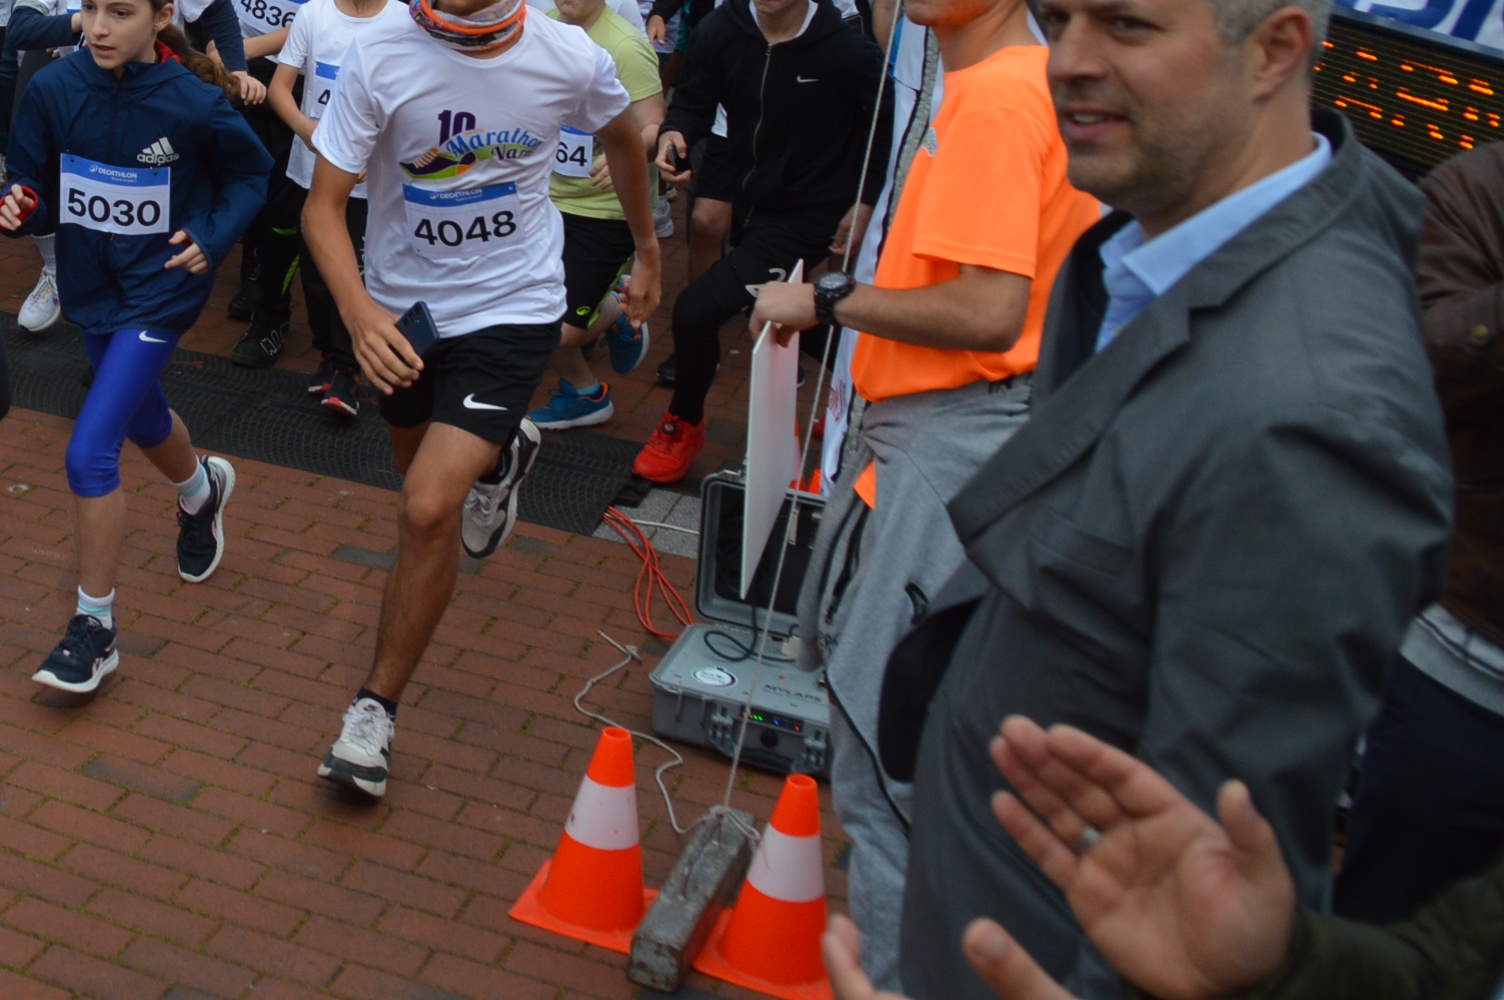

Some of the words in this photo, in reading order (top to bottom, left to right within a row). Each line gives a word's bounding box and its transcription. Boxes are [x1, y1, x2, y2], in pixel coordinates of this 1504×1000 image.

[438, 110, 476, 146] 10
[136, 153, 180, 164] adidas
[67, 187, 161, 227] 5030
[414, 210, 517, 247] 4048
